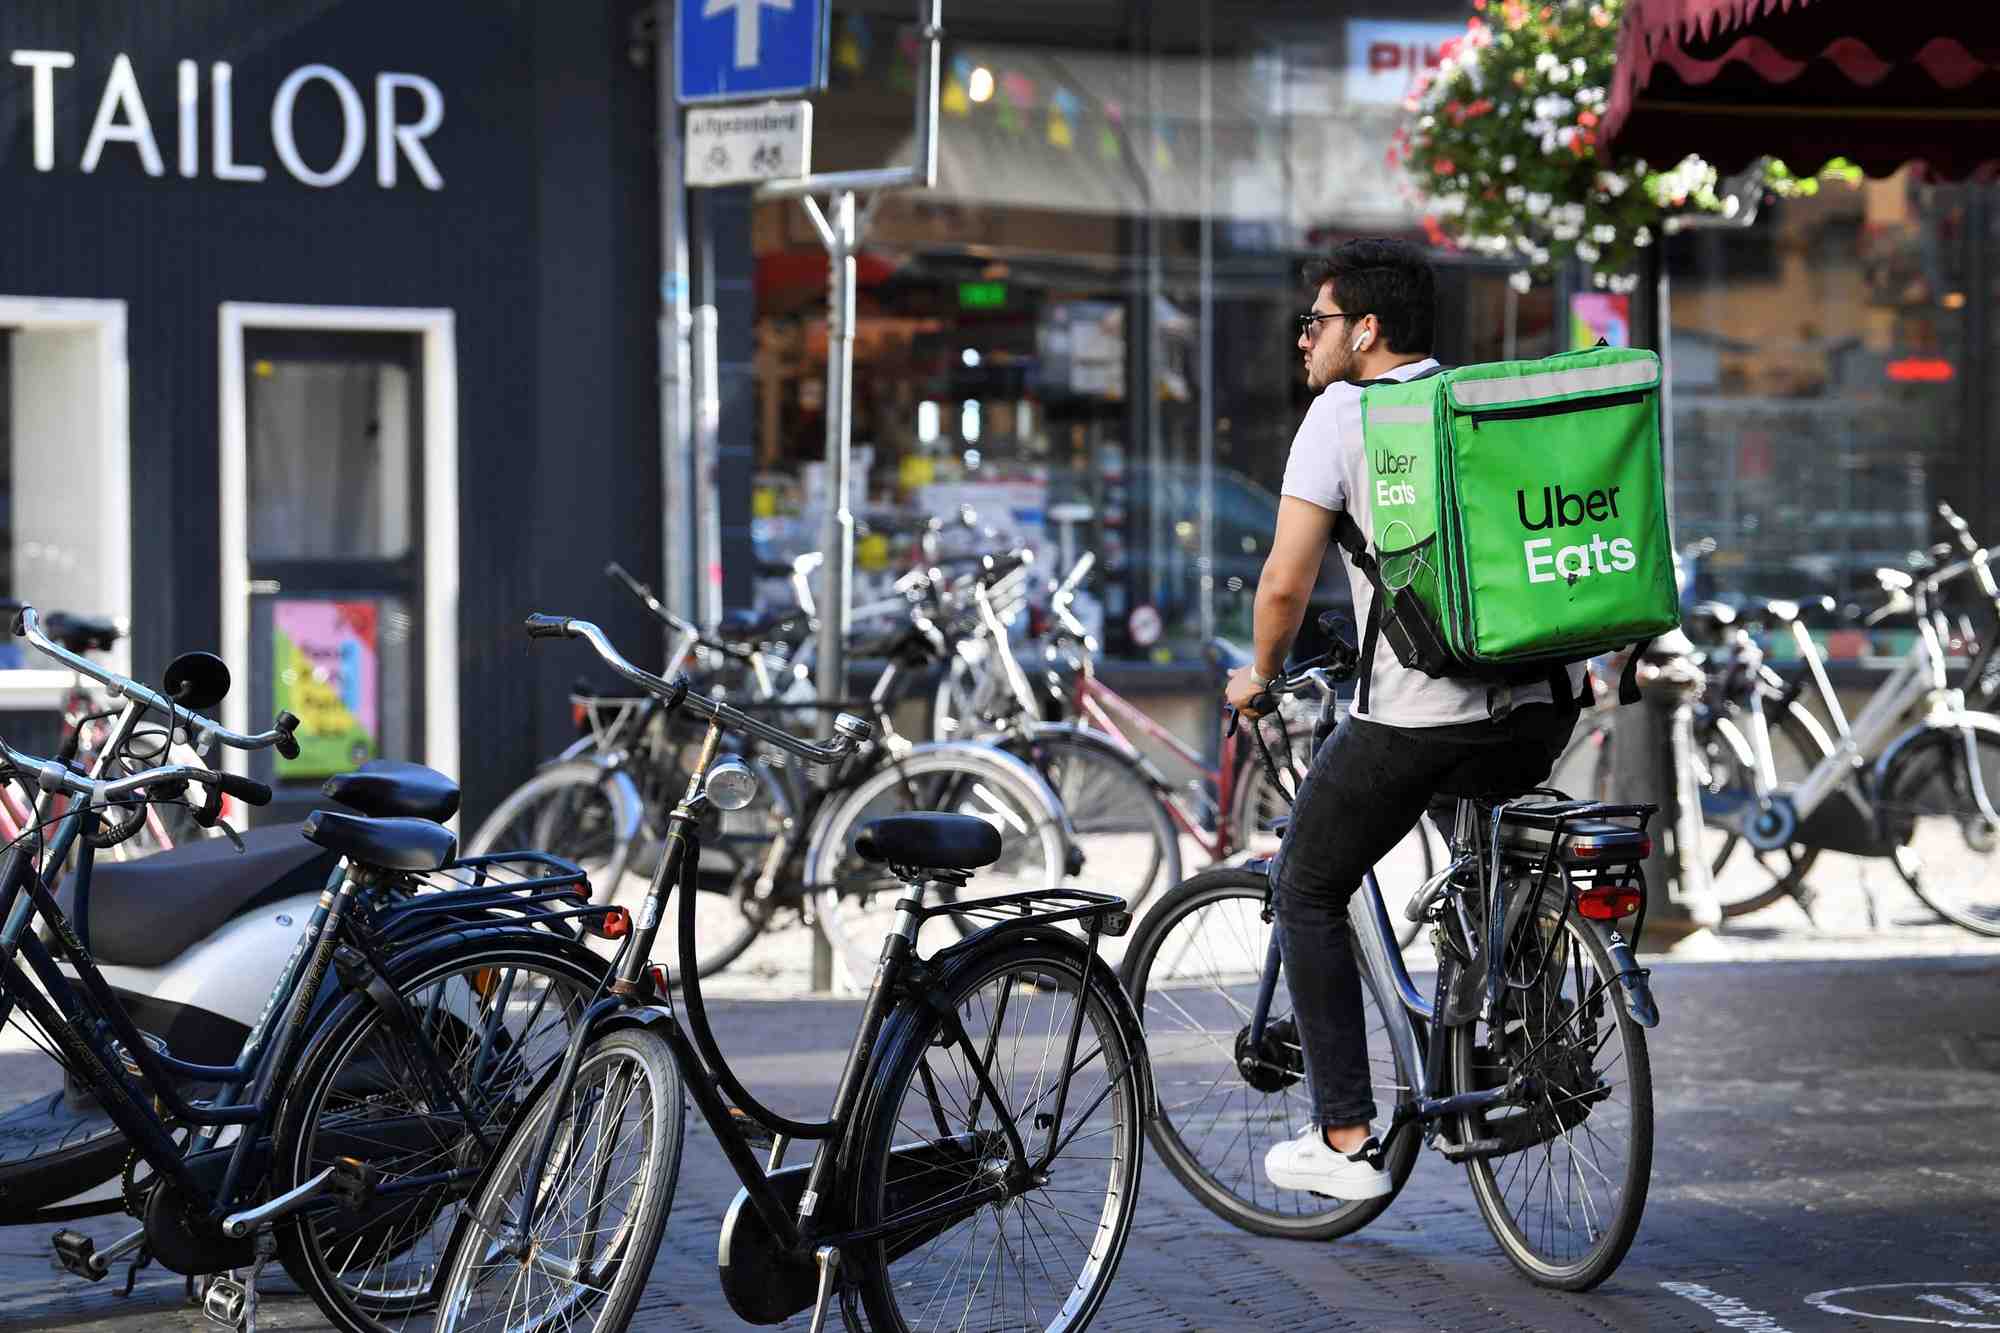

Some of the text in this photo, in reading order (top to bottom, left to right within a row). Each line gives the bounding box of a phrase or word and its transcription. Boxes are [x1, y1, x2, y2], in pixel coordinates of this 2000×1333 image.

[11, 49, 445, 191] TAILOR
[1375, 448, 1417, 475] Uber
[1376, 480, 1416, 506] Eats
[1517, 485, 1620, 531] Uber
[1523, 533, 1636, 583] Eats
